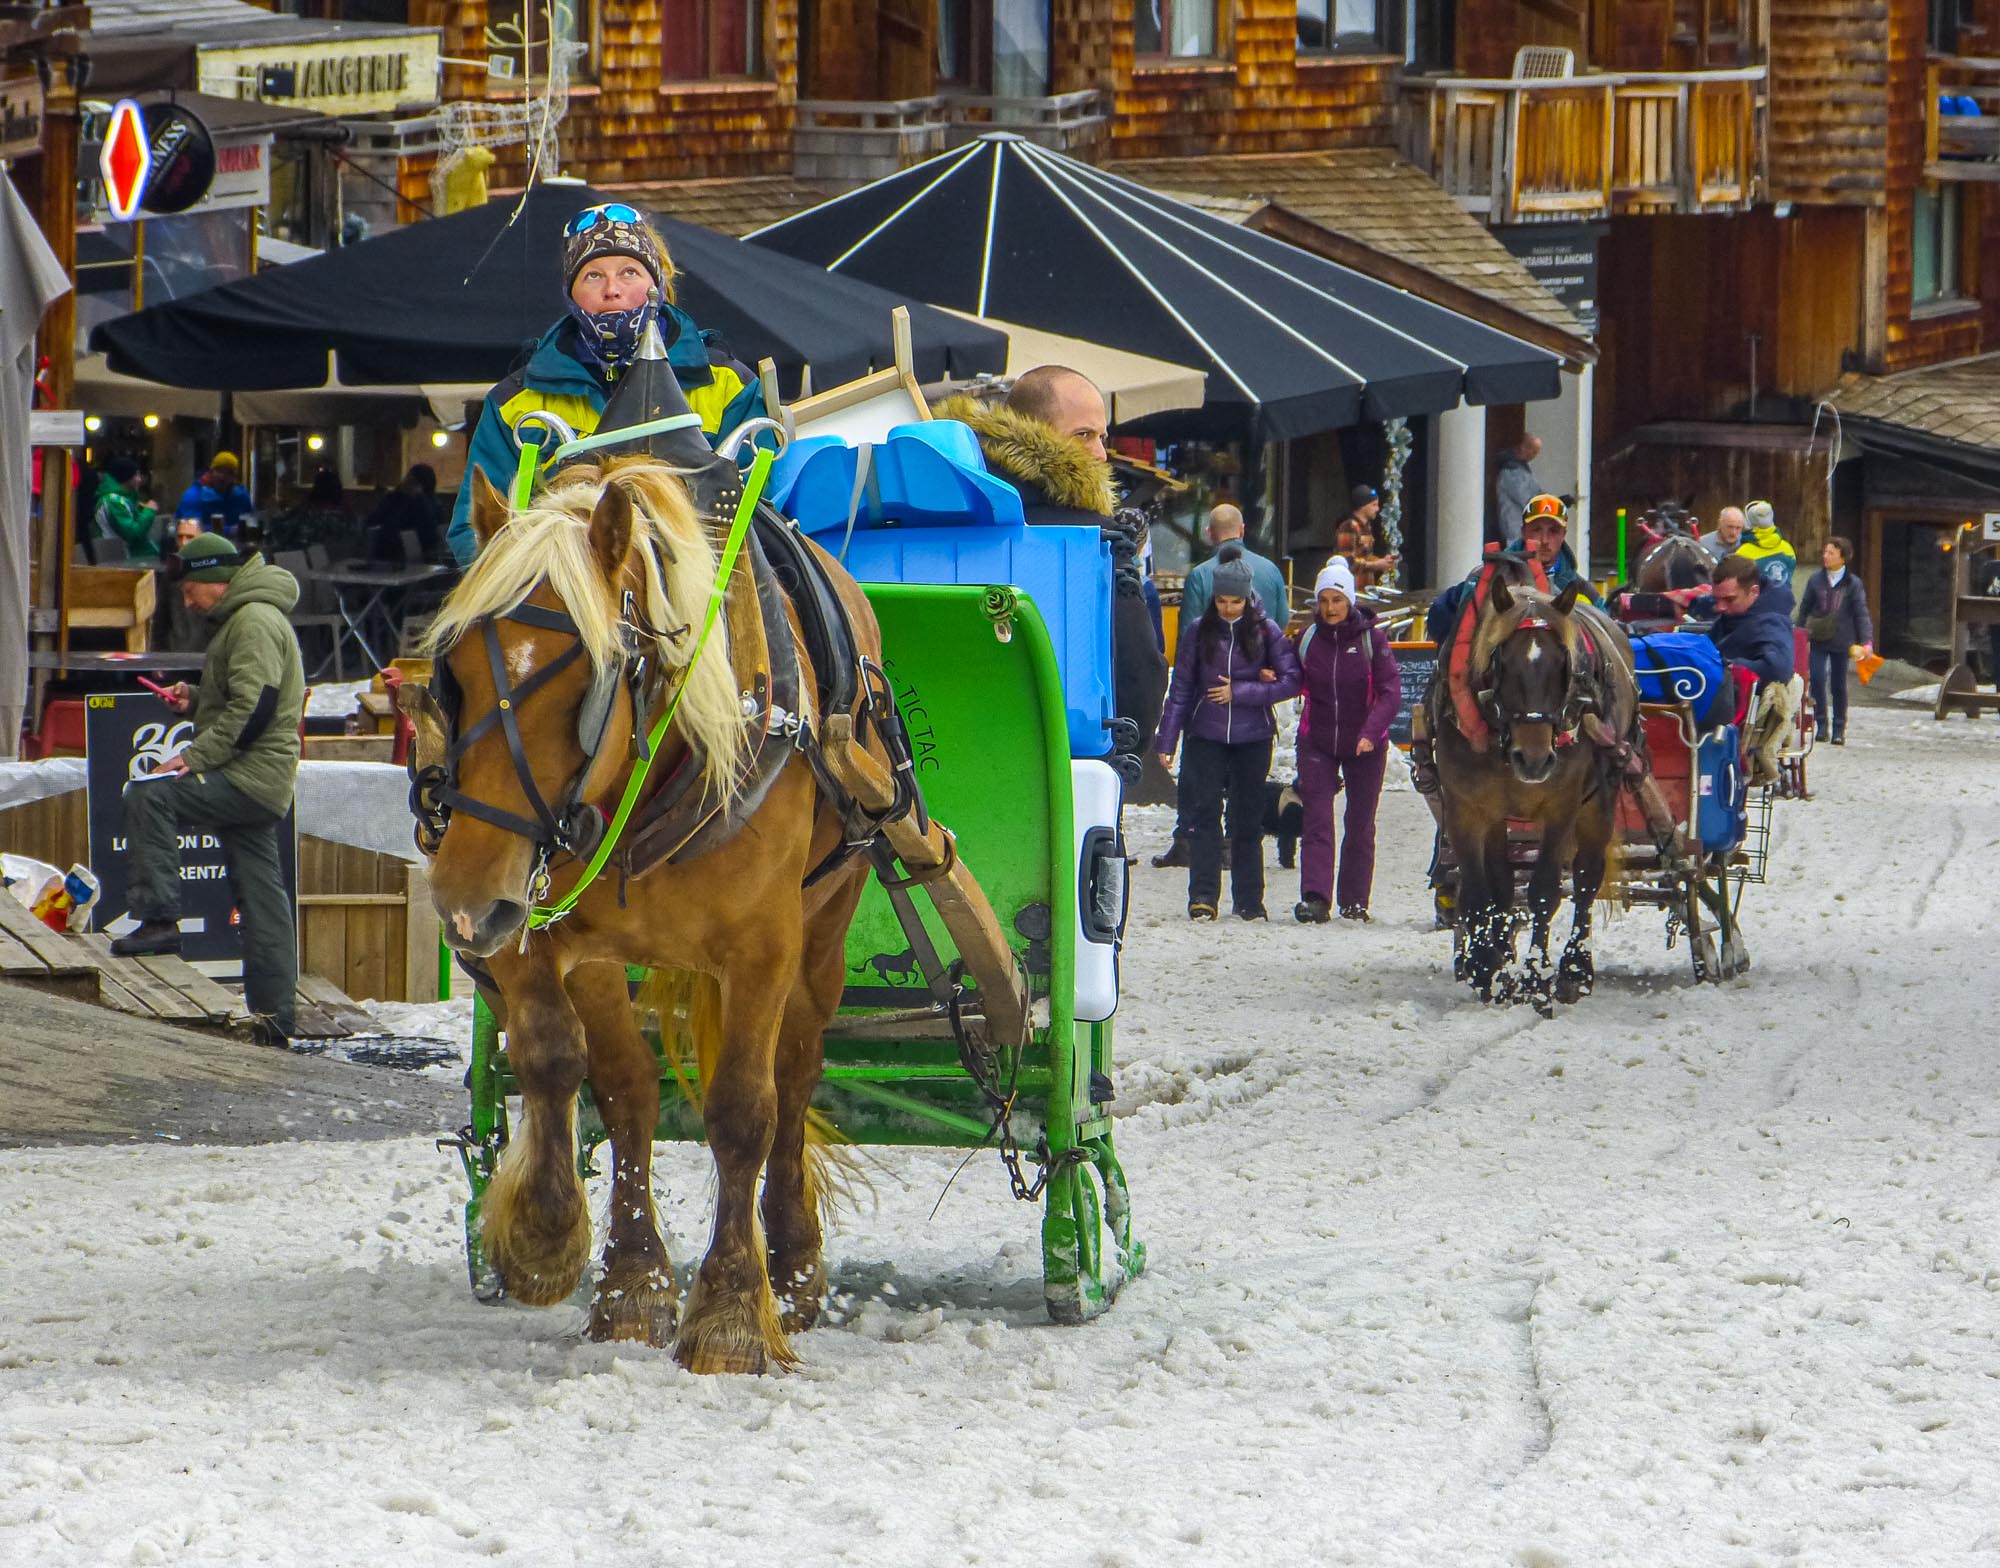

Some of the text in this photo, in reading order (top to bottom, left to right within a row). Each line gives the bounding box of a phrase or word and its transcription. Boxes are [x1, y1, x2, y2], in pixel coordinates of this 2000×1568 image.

[1555, 252, 1593, 266] BLANCHES
[898, 684, 928, 724] TIC
[914, 725, 940, 771] TAC
[178, 864, 228, 880] RENTA
